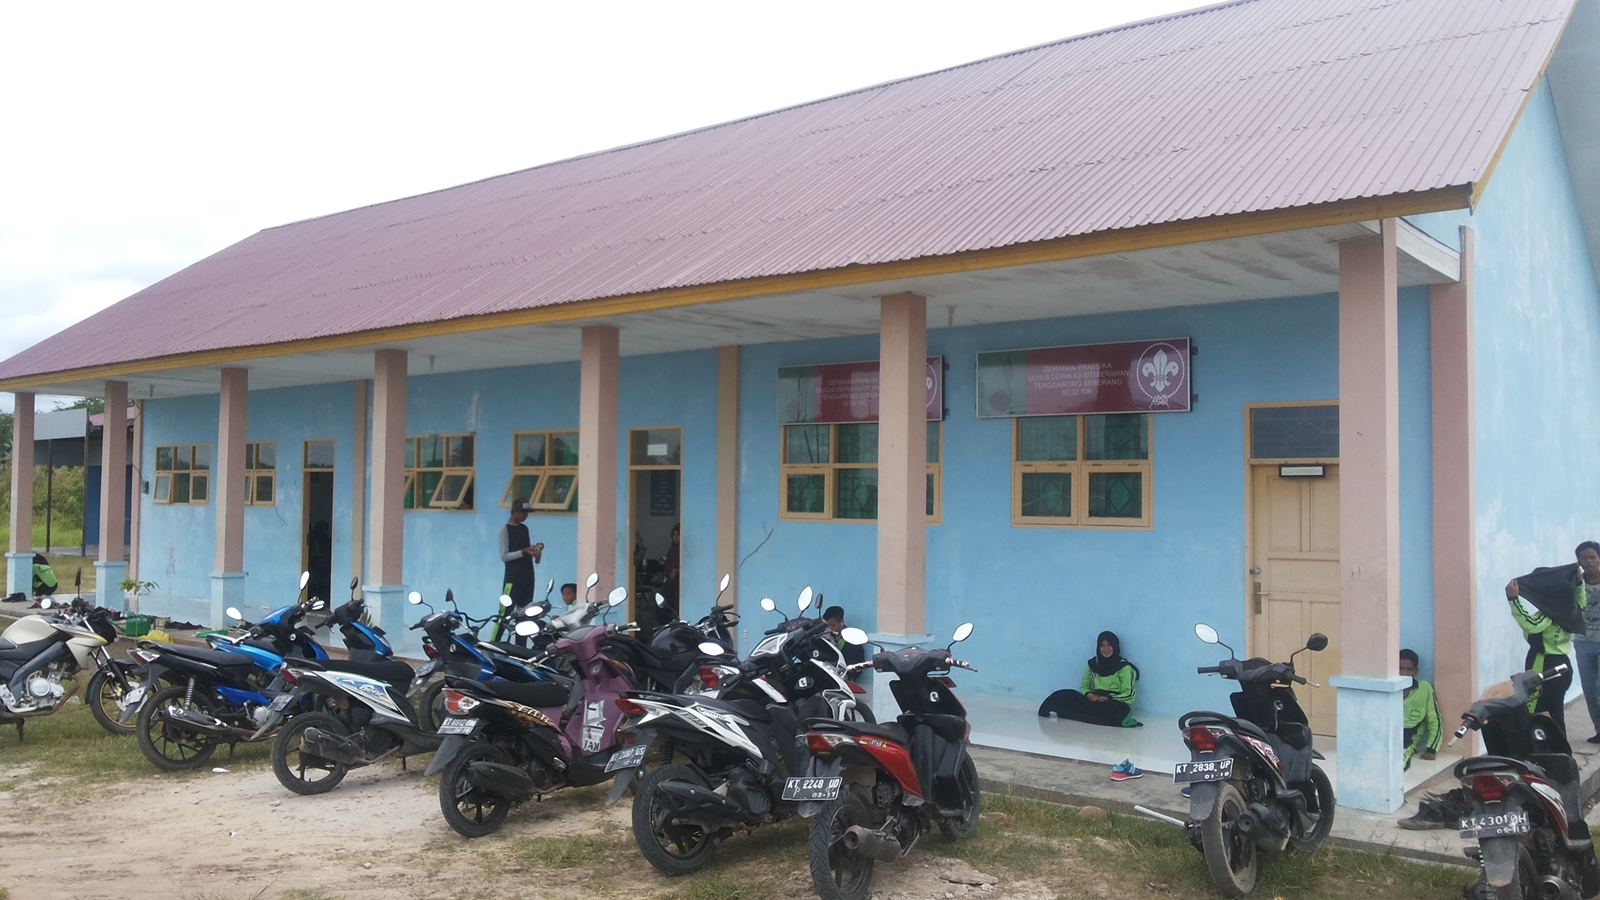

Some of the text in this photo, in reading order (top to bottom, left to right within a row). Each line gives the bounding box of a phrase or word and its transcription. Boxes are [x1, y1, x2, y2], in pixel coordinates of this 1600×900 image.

[1043, 362, 1112, 373] GERAKAN PRAMUKA
[1027, 374, 1050, 382] GUGUS
[1096, 369, 1129, 378] BERAWAN
[1034, 378, 1122, 389] TENGGARONG SEBERANG
[1176, 764, 1188, 774] KT
[1219, 760, 1231, 769] UP
[787, 779, 840, 789] KT 2248 UD
[1461, 816, 1477, 828] KT
